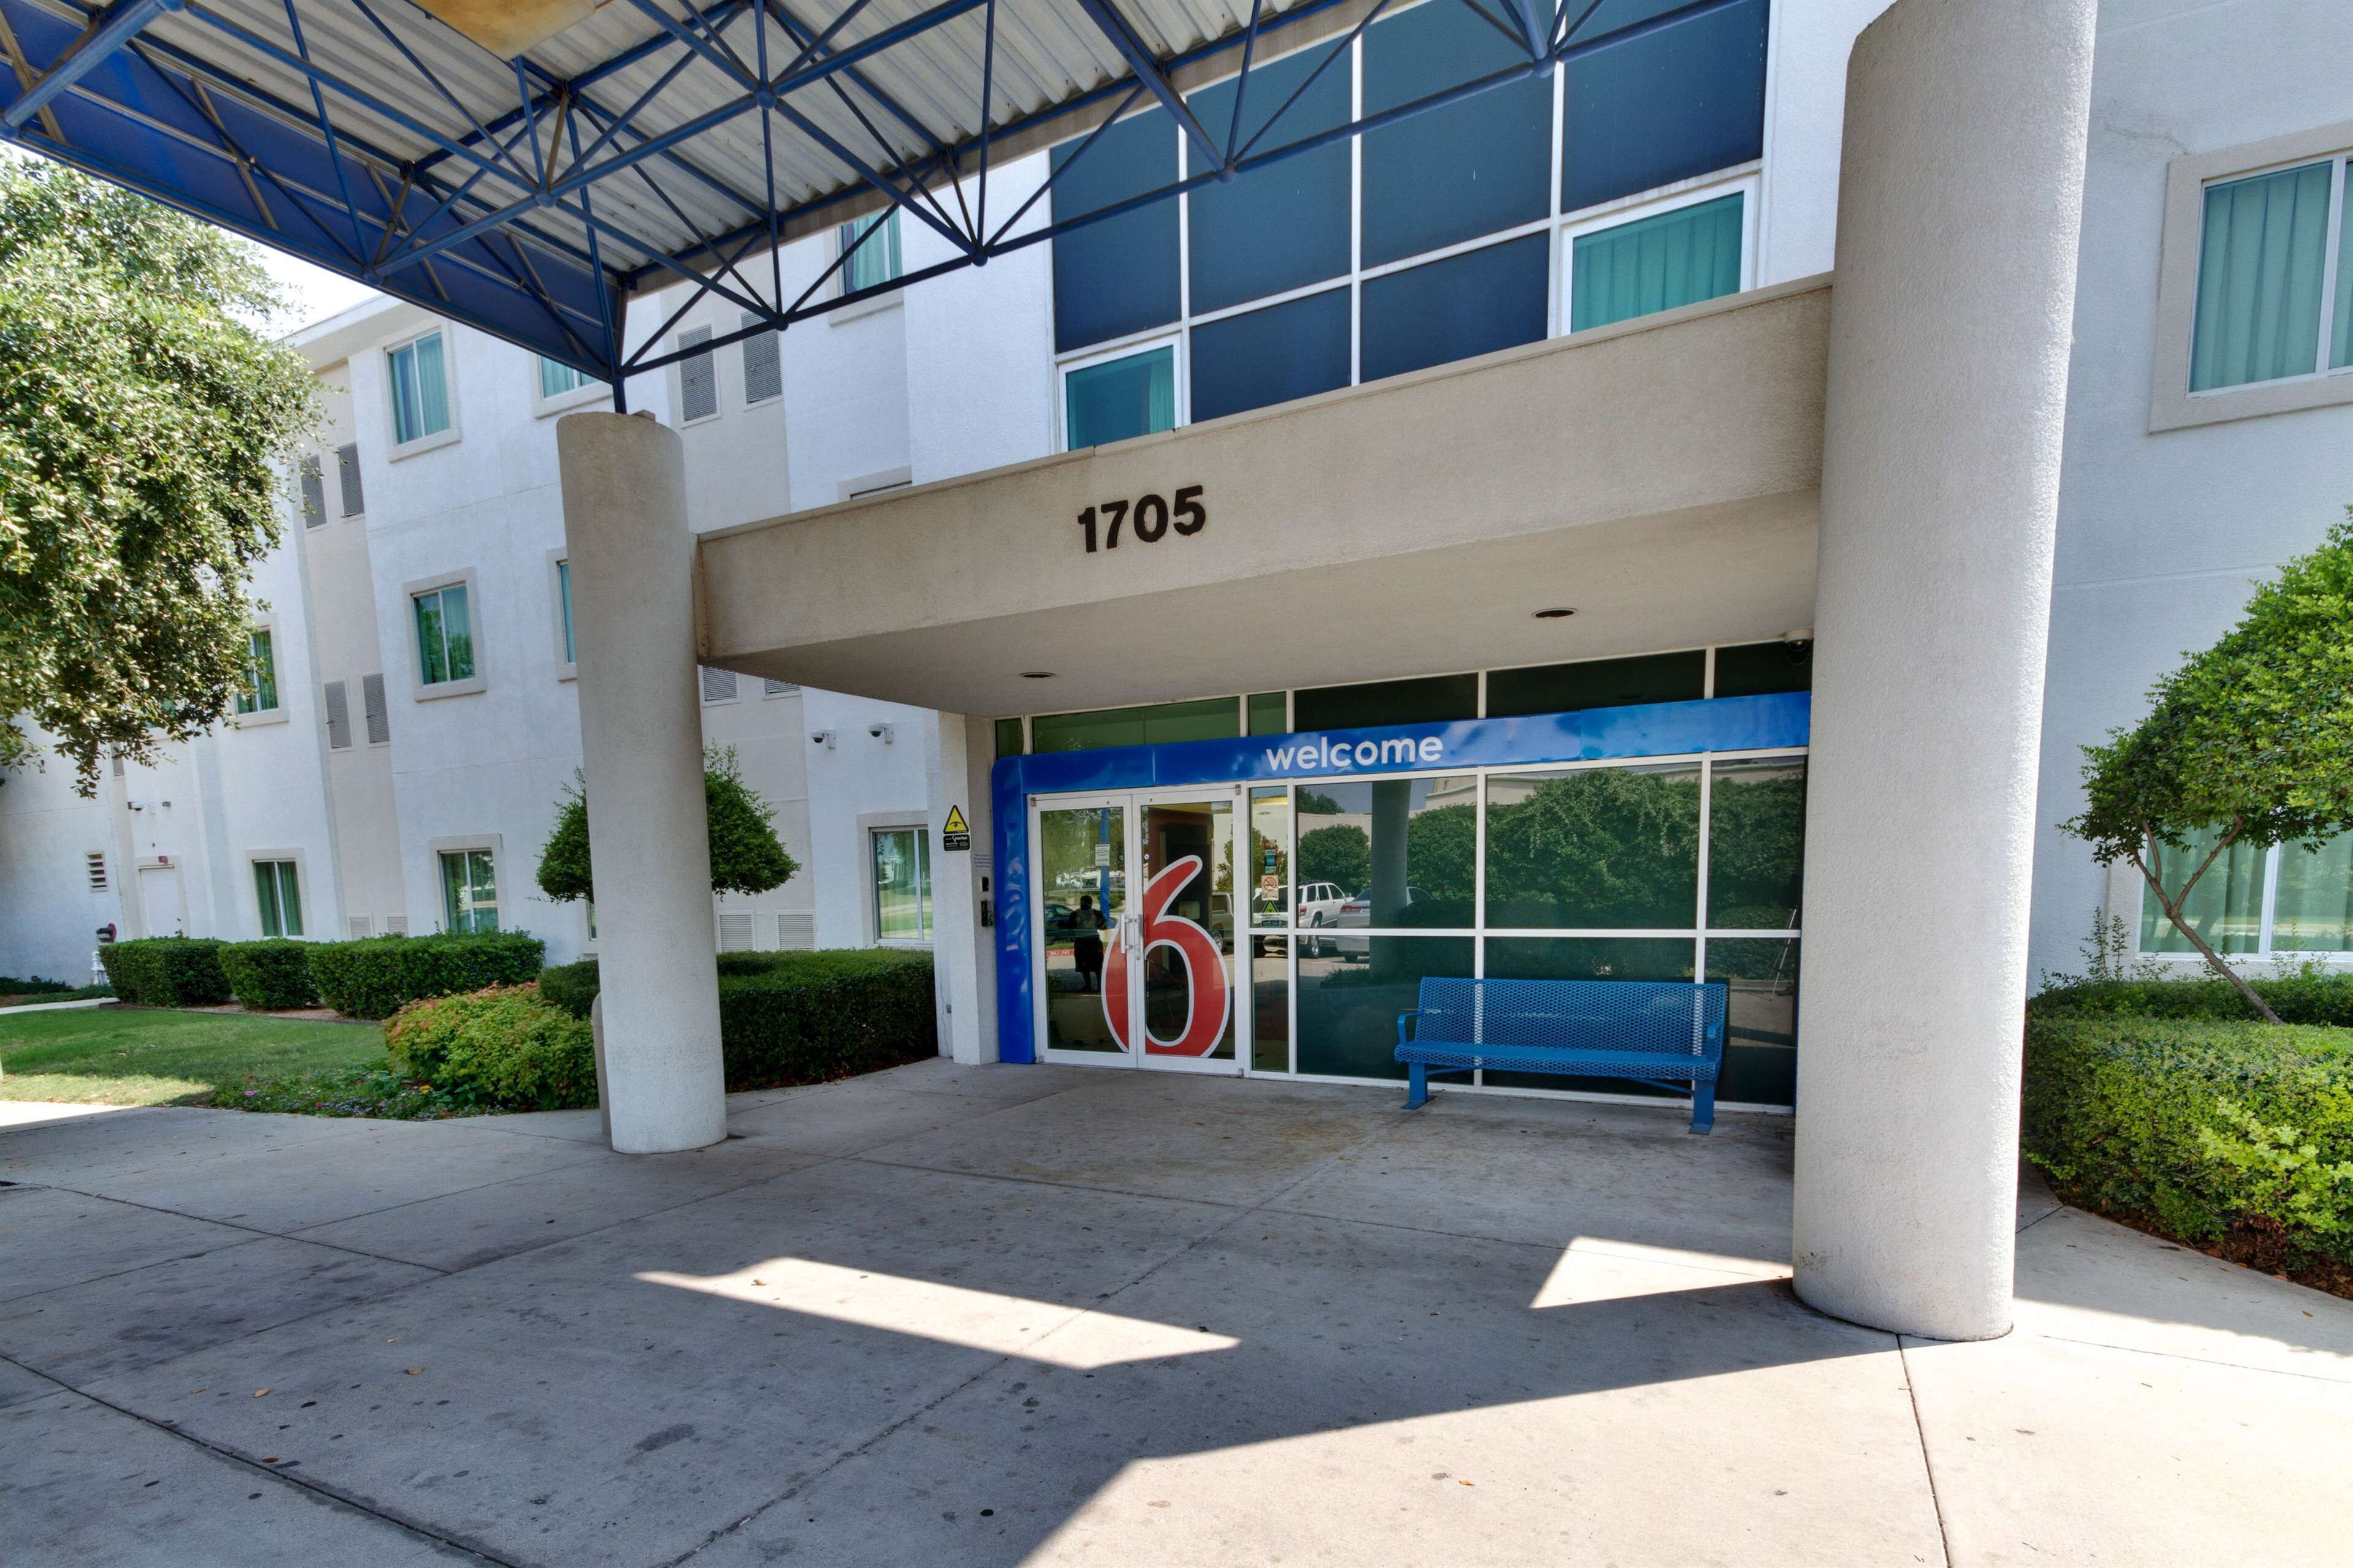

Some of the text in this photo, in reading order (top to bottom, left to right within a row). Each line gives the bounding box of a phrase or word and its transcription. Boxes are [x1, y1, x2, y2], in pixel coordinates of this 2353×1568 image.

[1078, 485, 1206, 553] 1705
[1266, 736, 1443, 771] welcome
[1101, 854, 1231, 1059] 6
